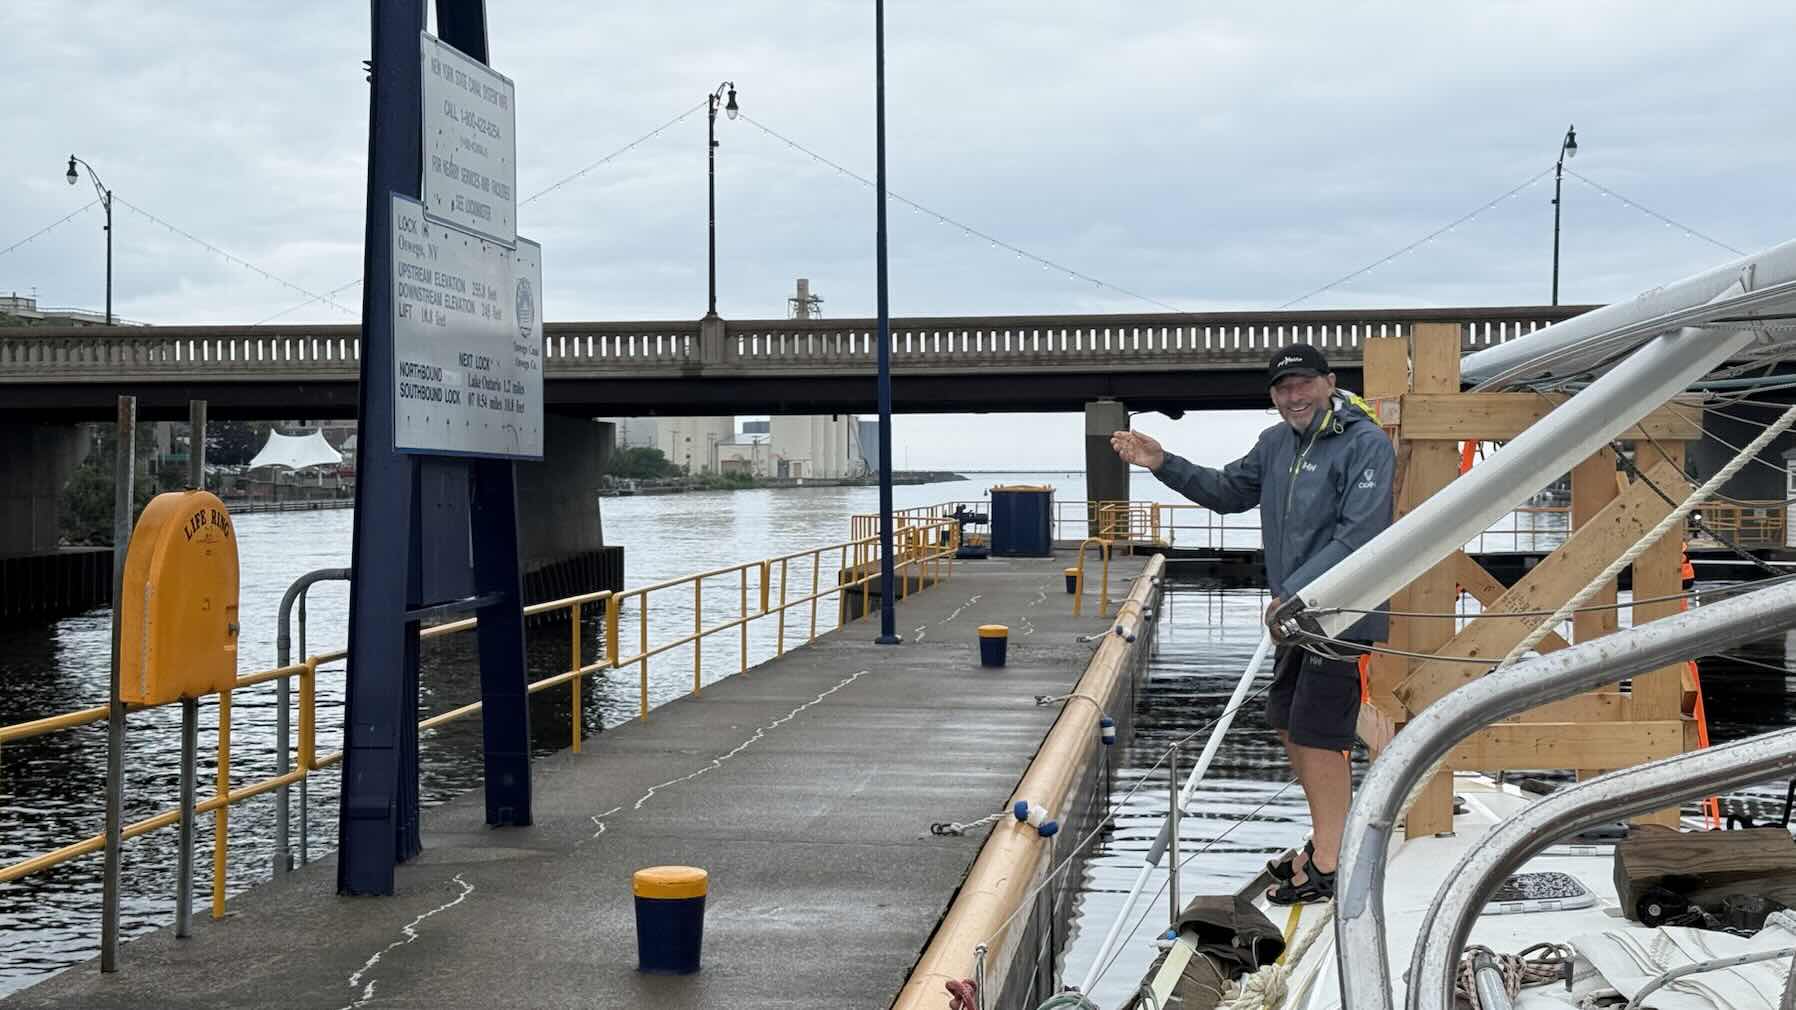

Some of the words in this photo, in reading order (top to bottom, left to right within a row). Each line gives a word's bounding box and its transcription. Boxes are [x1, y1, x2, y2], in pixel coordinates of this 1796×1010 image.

[398, 214, 417, 234] LOCK
[398, 260, 432, 285] UPSTREAM
[434, 271, 466, 294] ELEVATION
[398, 280, 442, 307] DOWNSTREAM
[444, 293, 476, 315] ELEVATION
[398, 301, 412, 321] LIFT
[399, 361, 443, 383] NORTHBOUND
[458, 352, 473, 369] NEXT
[475, 356, 490, 371] LOCK
[399, 381, 443, 403] SOUTHBOUND
[444, 387, 461, 405] LOCK
[184, 508, 207, 543] LIFE
[210, 508, 230, 538] RING
